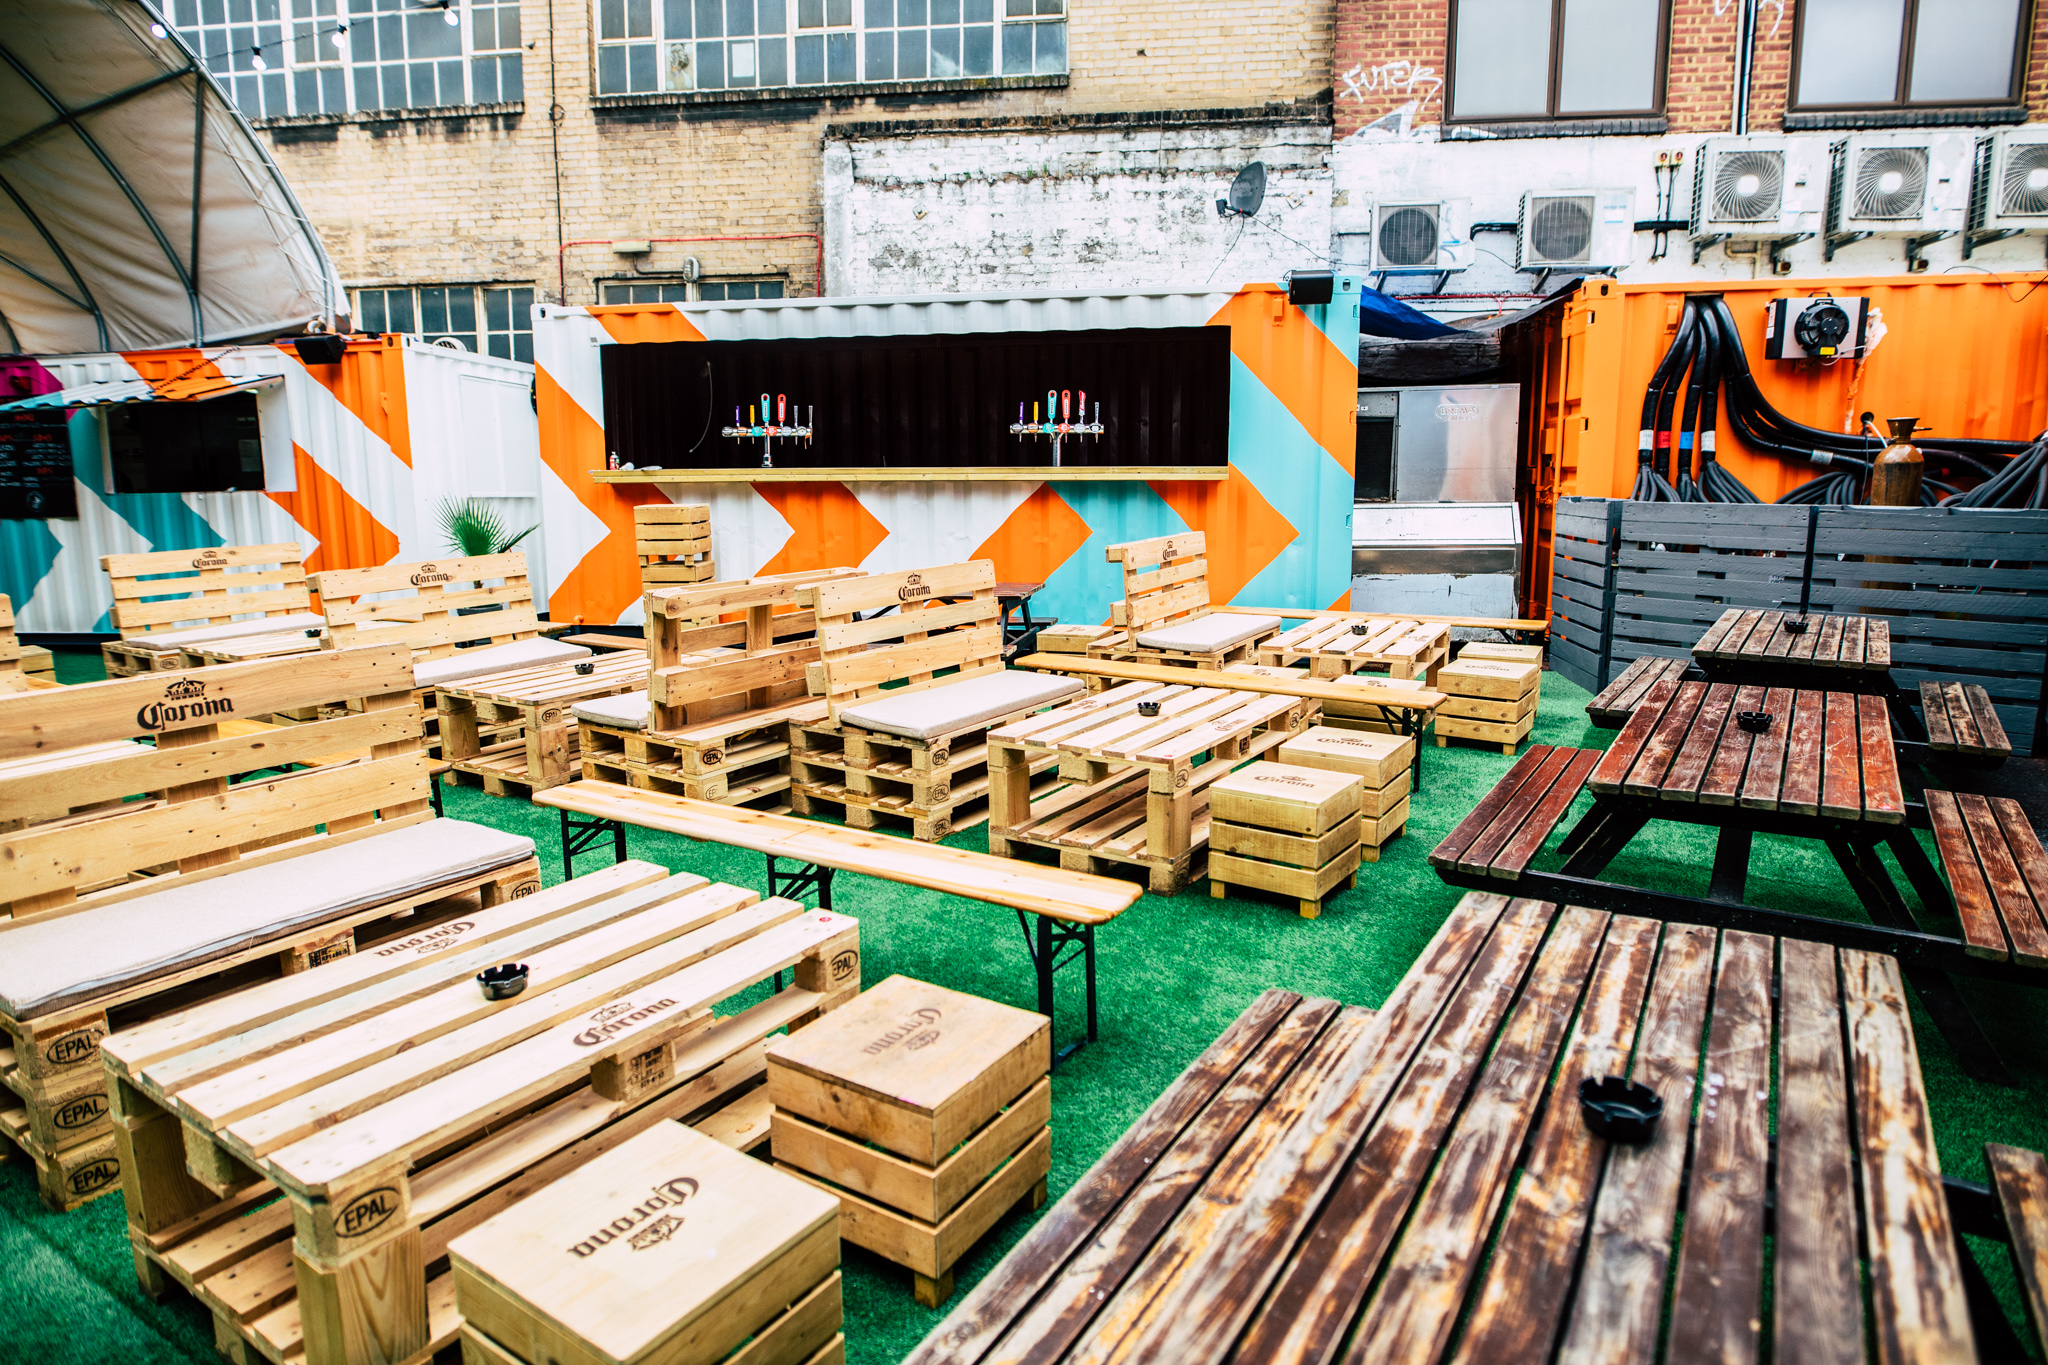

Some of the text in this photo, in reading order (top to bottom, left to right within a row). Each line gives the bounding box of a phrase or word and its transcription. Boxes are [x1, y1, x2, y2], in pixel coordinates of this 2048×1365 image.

[192, 557, 228, 569] Corona
[410, 572, 448, 586] Corona
[898, 585, 931, 602] Corona
[137, 698, 235, 731] Corona
[1317, 737, 1373, 748] Corona
[1254, 775, 1316, 788] Corona
[374, 920, 476, 957] Corona
[831, 955, 855, 978] EPAL
[573, 998, 680, 1047] Corona
[862, 1008, 942, 1056] Corona
[55, 1034, 99, 1061] EPAL
[62, 1099, 105, 1126] EPAL
[73, 1164, 116, 1192] EPAL
[343, 1194, 393, 1233] EPAL
[566, 1176, 699, 1259] Corona
